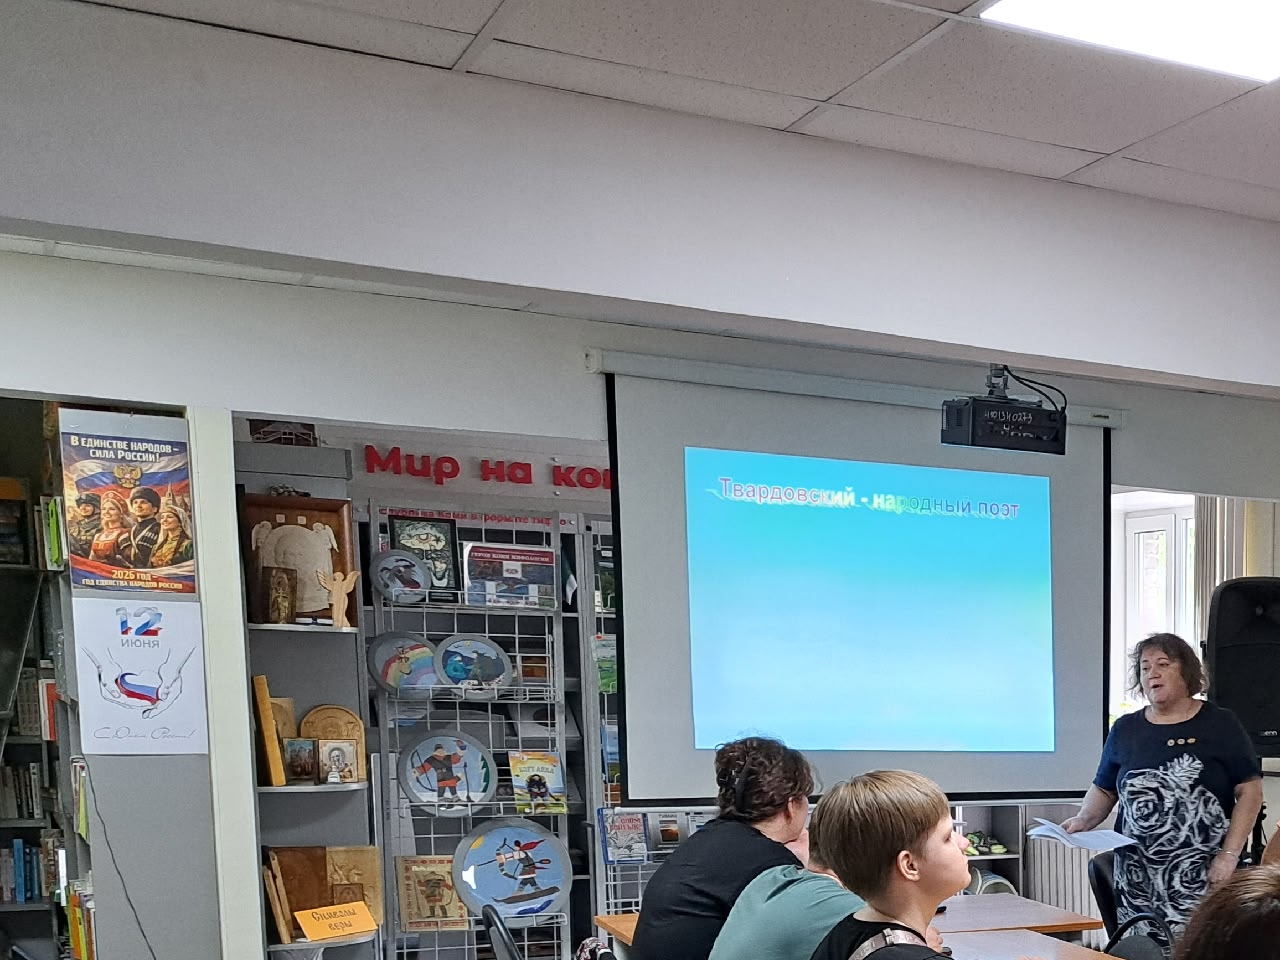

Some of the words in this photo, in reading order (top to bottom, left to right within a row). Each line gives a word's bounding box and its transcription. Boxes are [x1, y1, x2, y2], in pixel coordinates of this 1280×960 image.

[70, 435, 80, 446] В
[81, 437, 129, 450] ЕДИНСТВЕ
[130, 442, 172, 454] НАРОДОВ
[89, 449, 116, 459] СИЛА
[365, 445, 460, 485] Мир
[481, 459, 533, 485] на
[719, 477, 856, 507] Твардовский
[873, 493, 972, 514] народный
[978, 502, 1019, 518] поэт
[532, 516, 566, 527] тифо
[112, 570, 135, 580] 2026
[116, 607, 164, 636] 12
[121, 639, 160, 648] ИЮНЯ
